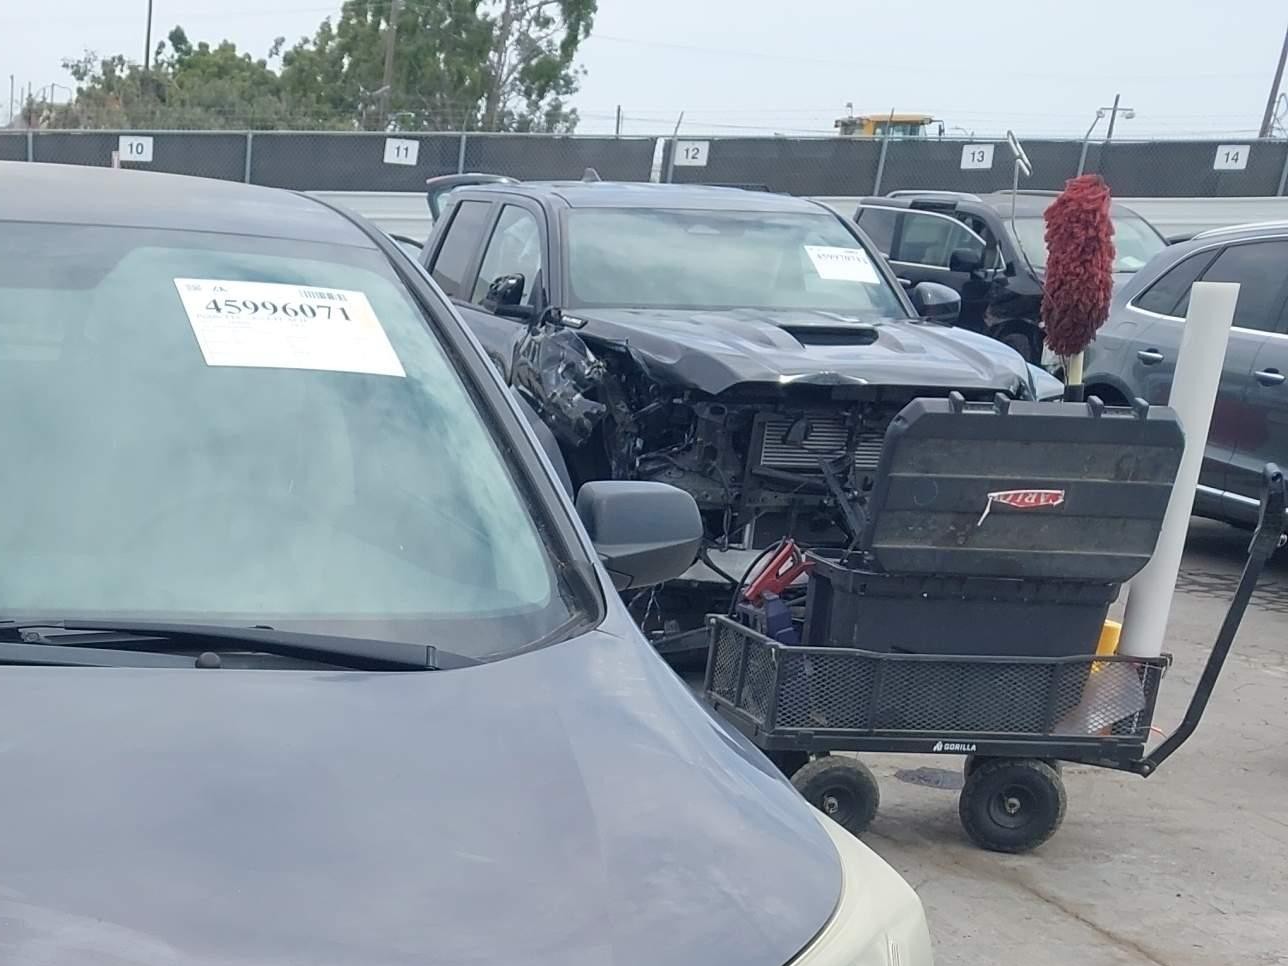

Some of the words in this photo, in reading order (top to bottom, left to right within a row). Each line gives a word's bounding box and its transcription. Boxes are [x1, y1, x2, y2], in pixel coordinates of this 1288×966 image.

[127, 142, 144, 155] 10
[395, 144, 409, 159] 11
[684, 147, 700, 160] 12
[969, 150, 985, 163] 13
[1224, 151, 1239, 164] 14
[204, 298, 352, 322] 45996071
[943, 743, 977, 752] GORILLA
